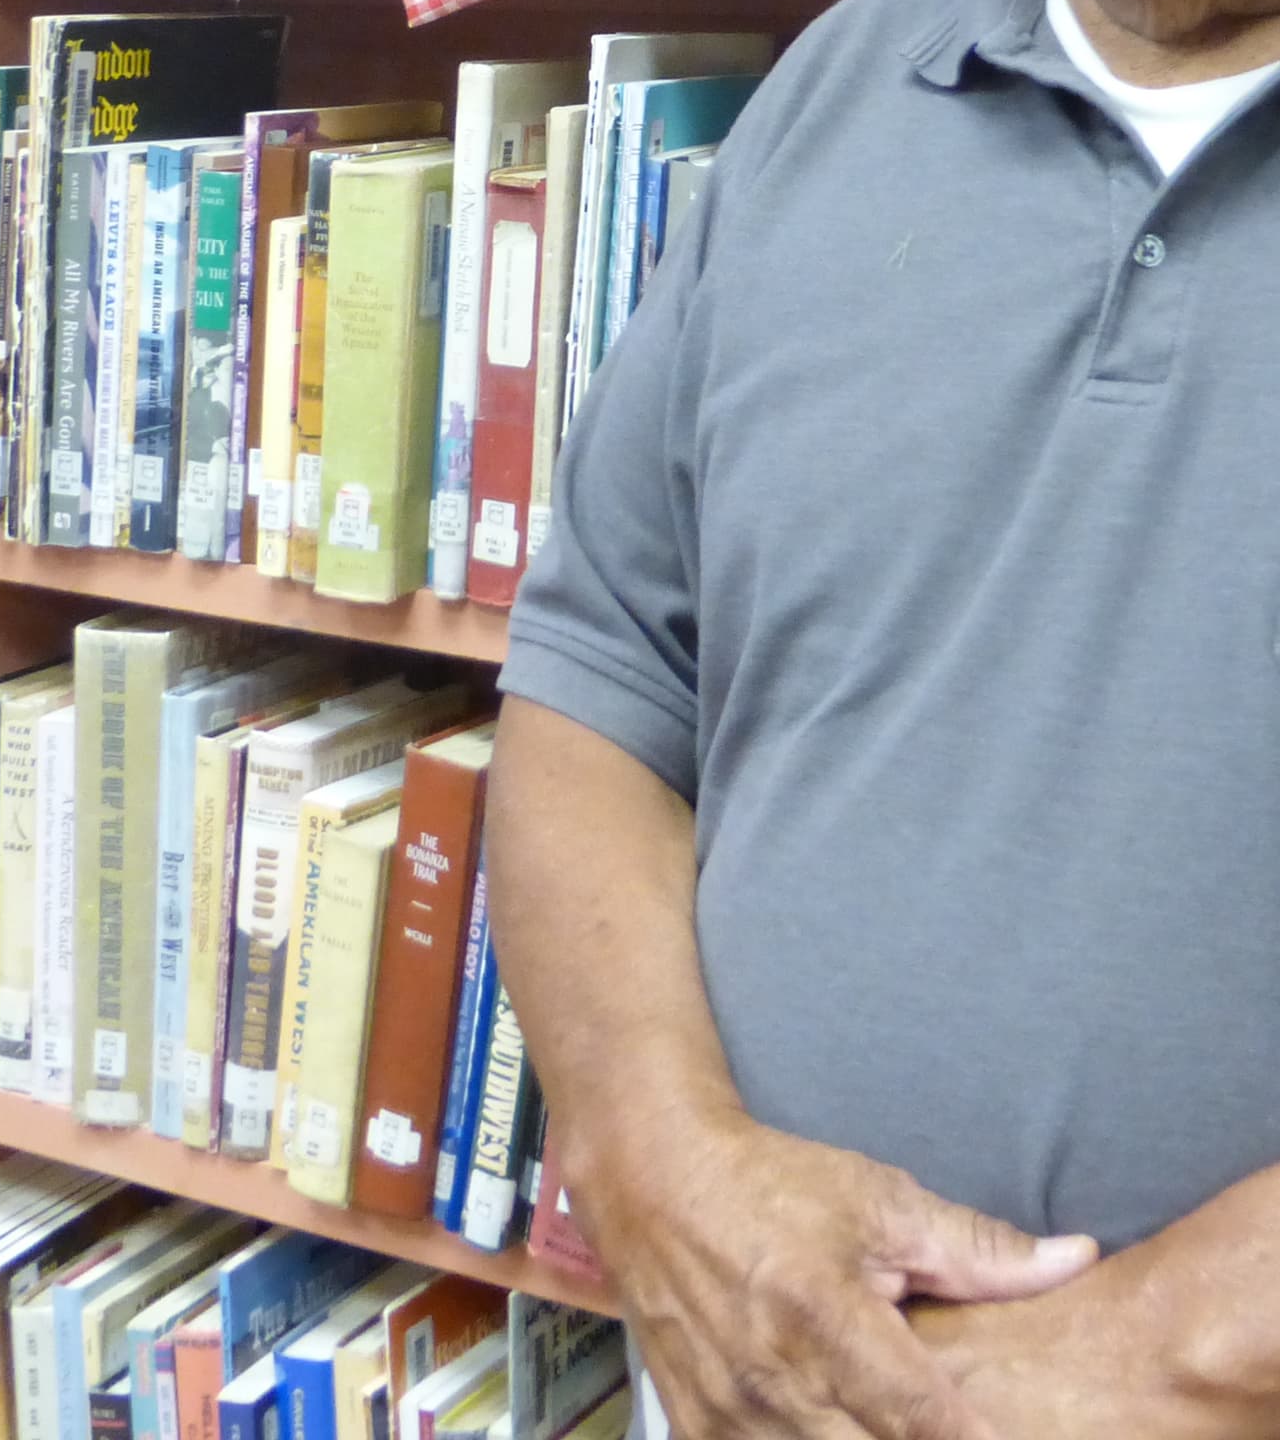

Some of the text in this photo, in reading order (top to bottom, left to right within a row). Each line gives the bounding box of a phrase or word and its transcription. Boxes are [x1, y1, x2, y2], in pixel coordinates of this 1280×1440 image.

[67, 171, 81, 221] KATIE LEE
[463, 183, 477, 197] A
[104, 198, 120, 331] LEVI'S & LACE
[197, 237, 227, 255] CITY
[236, 155, 257, 364] ANCIENT TREASURES OF THE SOUTHWEST
[151, 220, 166, 335] INSIDE AN AMERICAN
[207, 267, 230, 280] THE
[354, 271, 375, 283] The
[457, 255, 474, 300] Sketch
[195, 290, 225, 307] SUN
[59, 257, 82, 409] All My Rivers Are
[454, 303, 470, 334] Book
[7, 741, 32, 752] WHO
[8, 726, 31, 740] MEN
[1, 753, 38, 767] BUILT
[7, 770, 29, 783] THE
[249, 761, 304, 782] HAMPTON
[3, 786, 36, 799] WEST
[98, 645, 126, 1022] THE BOOK OF THE AMERICAN
[419, 831, 439, 852] THE
[198, 794, 217, 953] MINING FRONTIERS
[406, 843, 450, 872] BONANZA
[413, 862, 439, 885] TRAIL
[57, 791, 75, 972] A Rendezvous Reader
[251, 847, 280, 920] BLOOD
[160, 850, 185, 983] BEST WEST
[465, 871, 487, 981] PUEBLO BOY
[248, 927, 274, 974] AND
[290, 859, 322, 1065] AMERICAN WEST
[474, 1003, 524, 1178] SOUTHWEST
